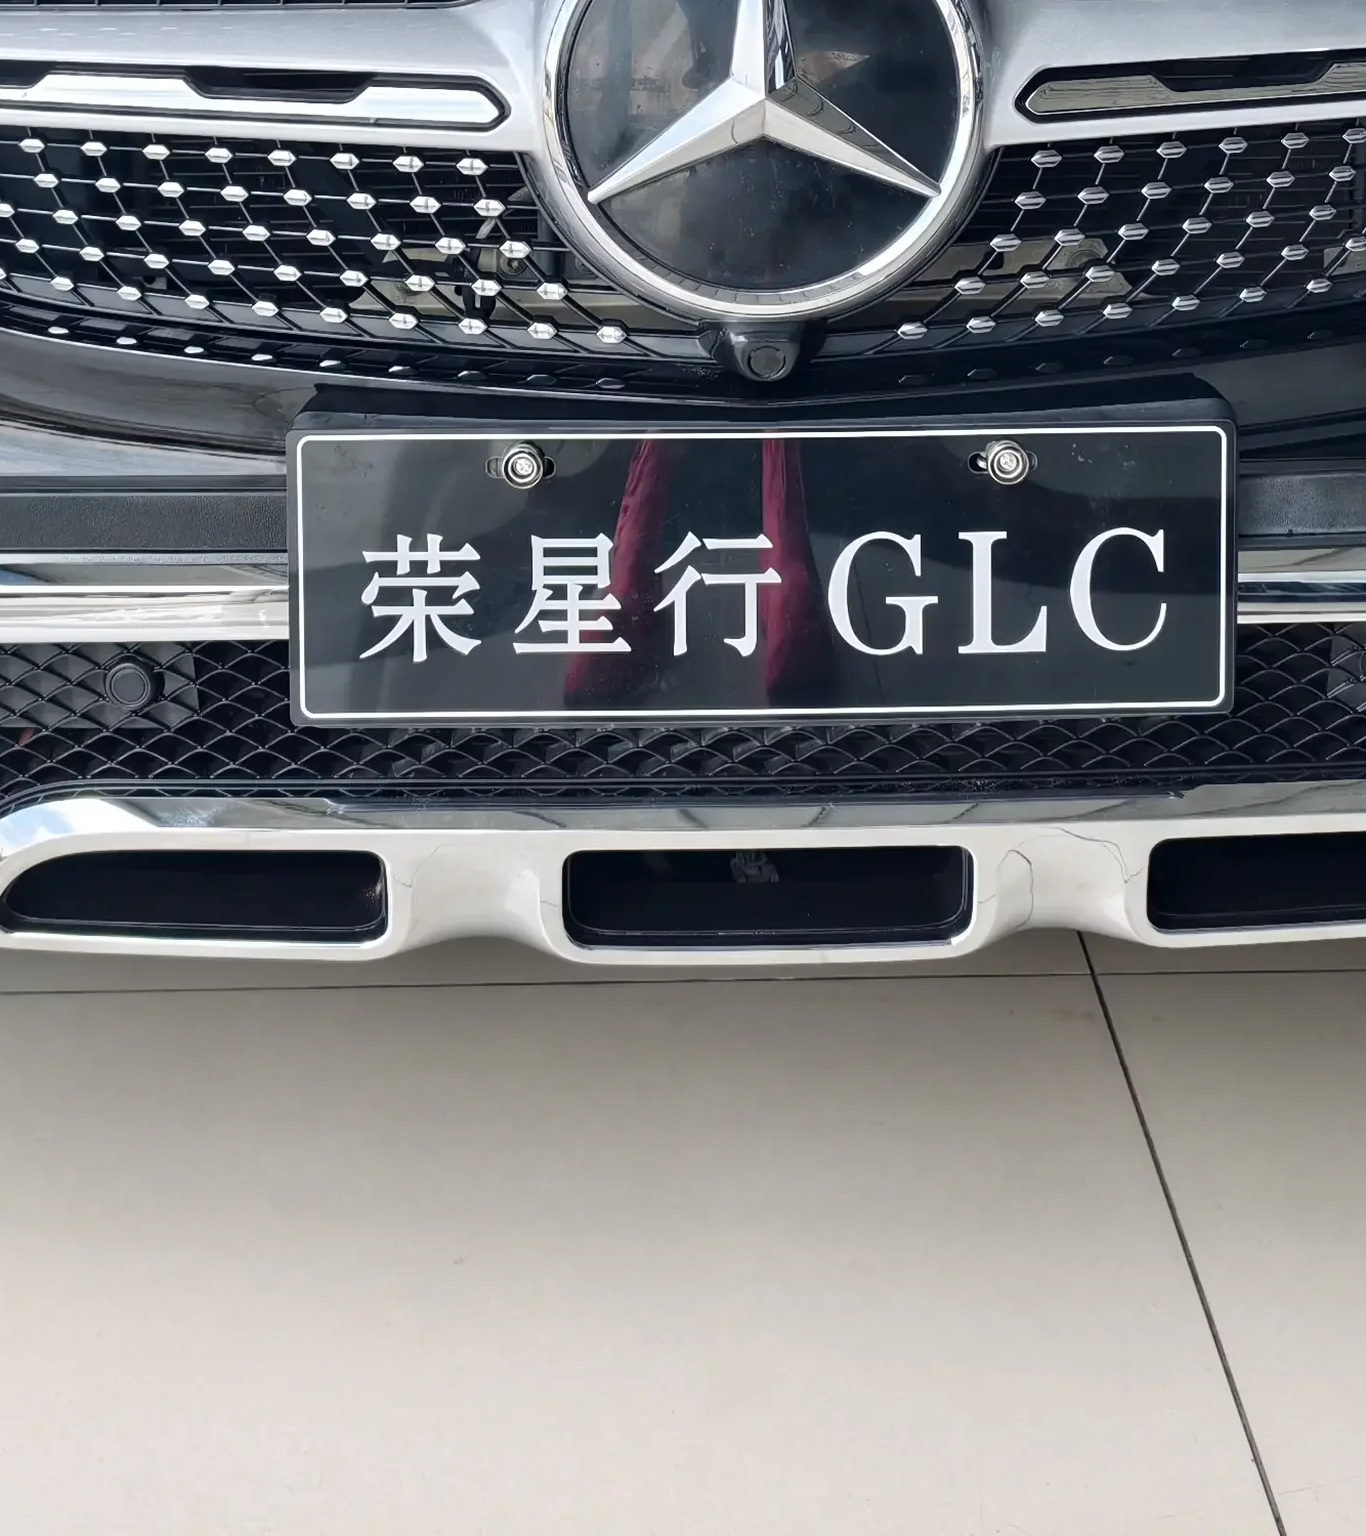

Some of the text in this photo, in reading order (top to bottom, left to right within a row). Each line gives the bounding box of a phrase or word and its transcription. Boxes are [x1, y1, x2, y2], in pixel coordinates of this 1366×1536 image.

[359, 526, 1169, 662] 荣星行 GLC
